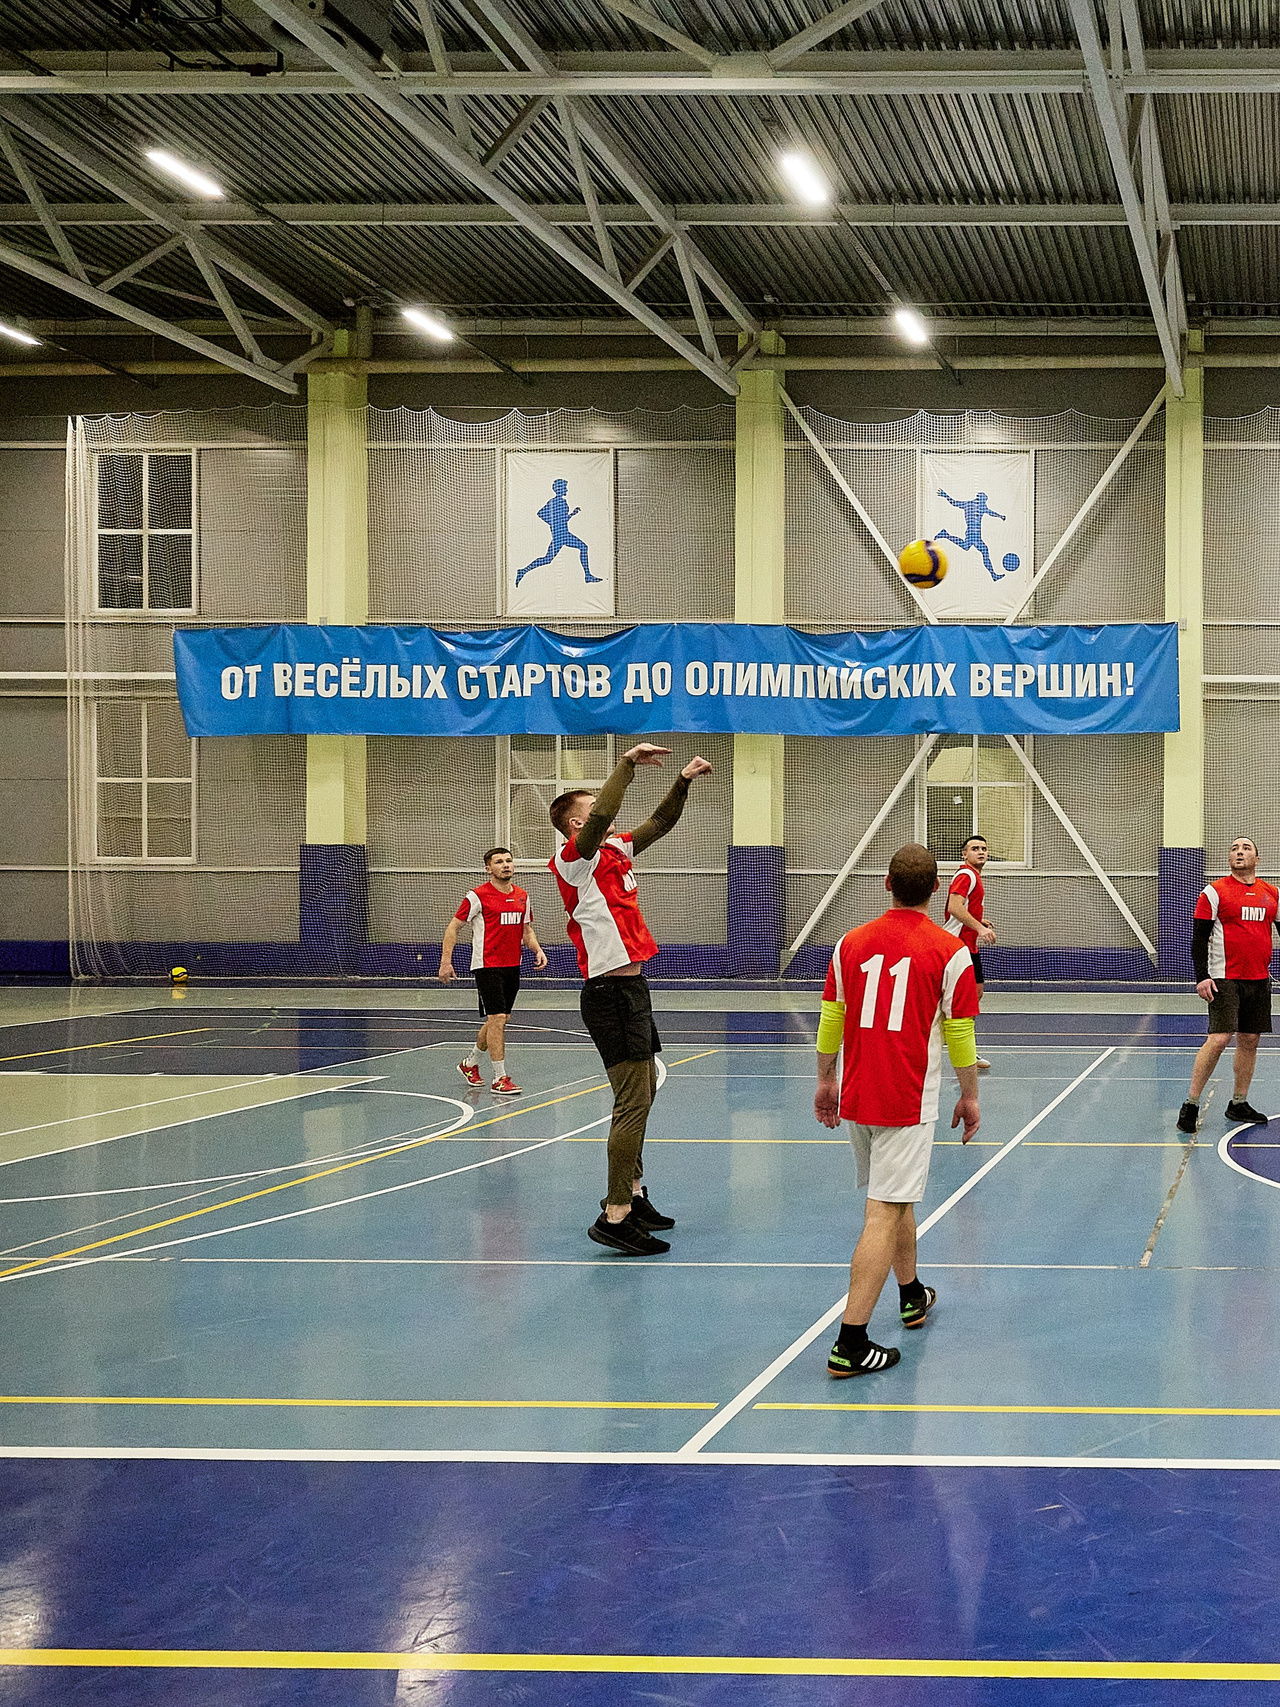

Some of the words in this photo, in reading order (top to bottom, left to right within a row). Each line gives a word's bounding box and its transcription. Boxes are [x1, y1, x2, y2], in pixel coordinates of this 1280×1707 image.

[220, 663, 262, 700] ОТ
[273, 657, 449, 699] ВЕСЁЛЫХ
[457, 662, 612, 699] СТАРТОВ
[623, 660, 672, 704] ДО
[685, 660, 957, 700] ОЛИМПИЙСКИХ
[969, 661, 1136, 698] ВЕРШИН!
[500, 911, 523, 926] ПМУ
[1241, 906, 1266, 922] ПМУ
[859, 953, 912, 1032] 11
